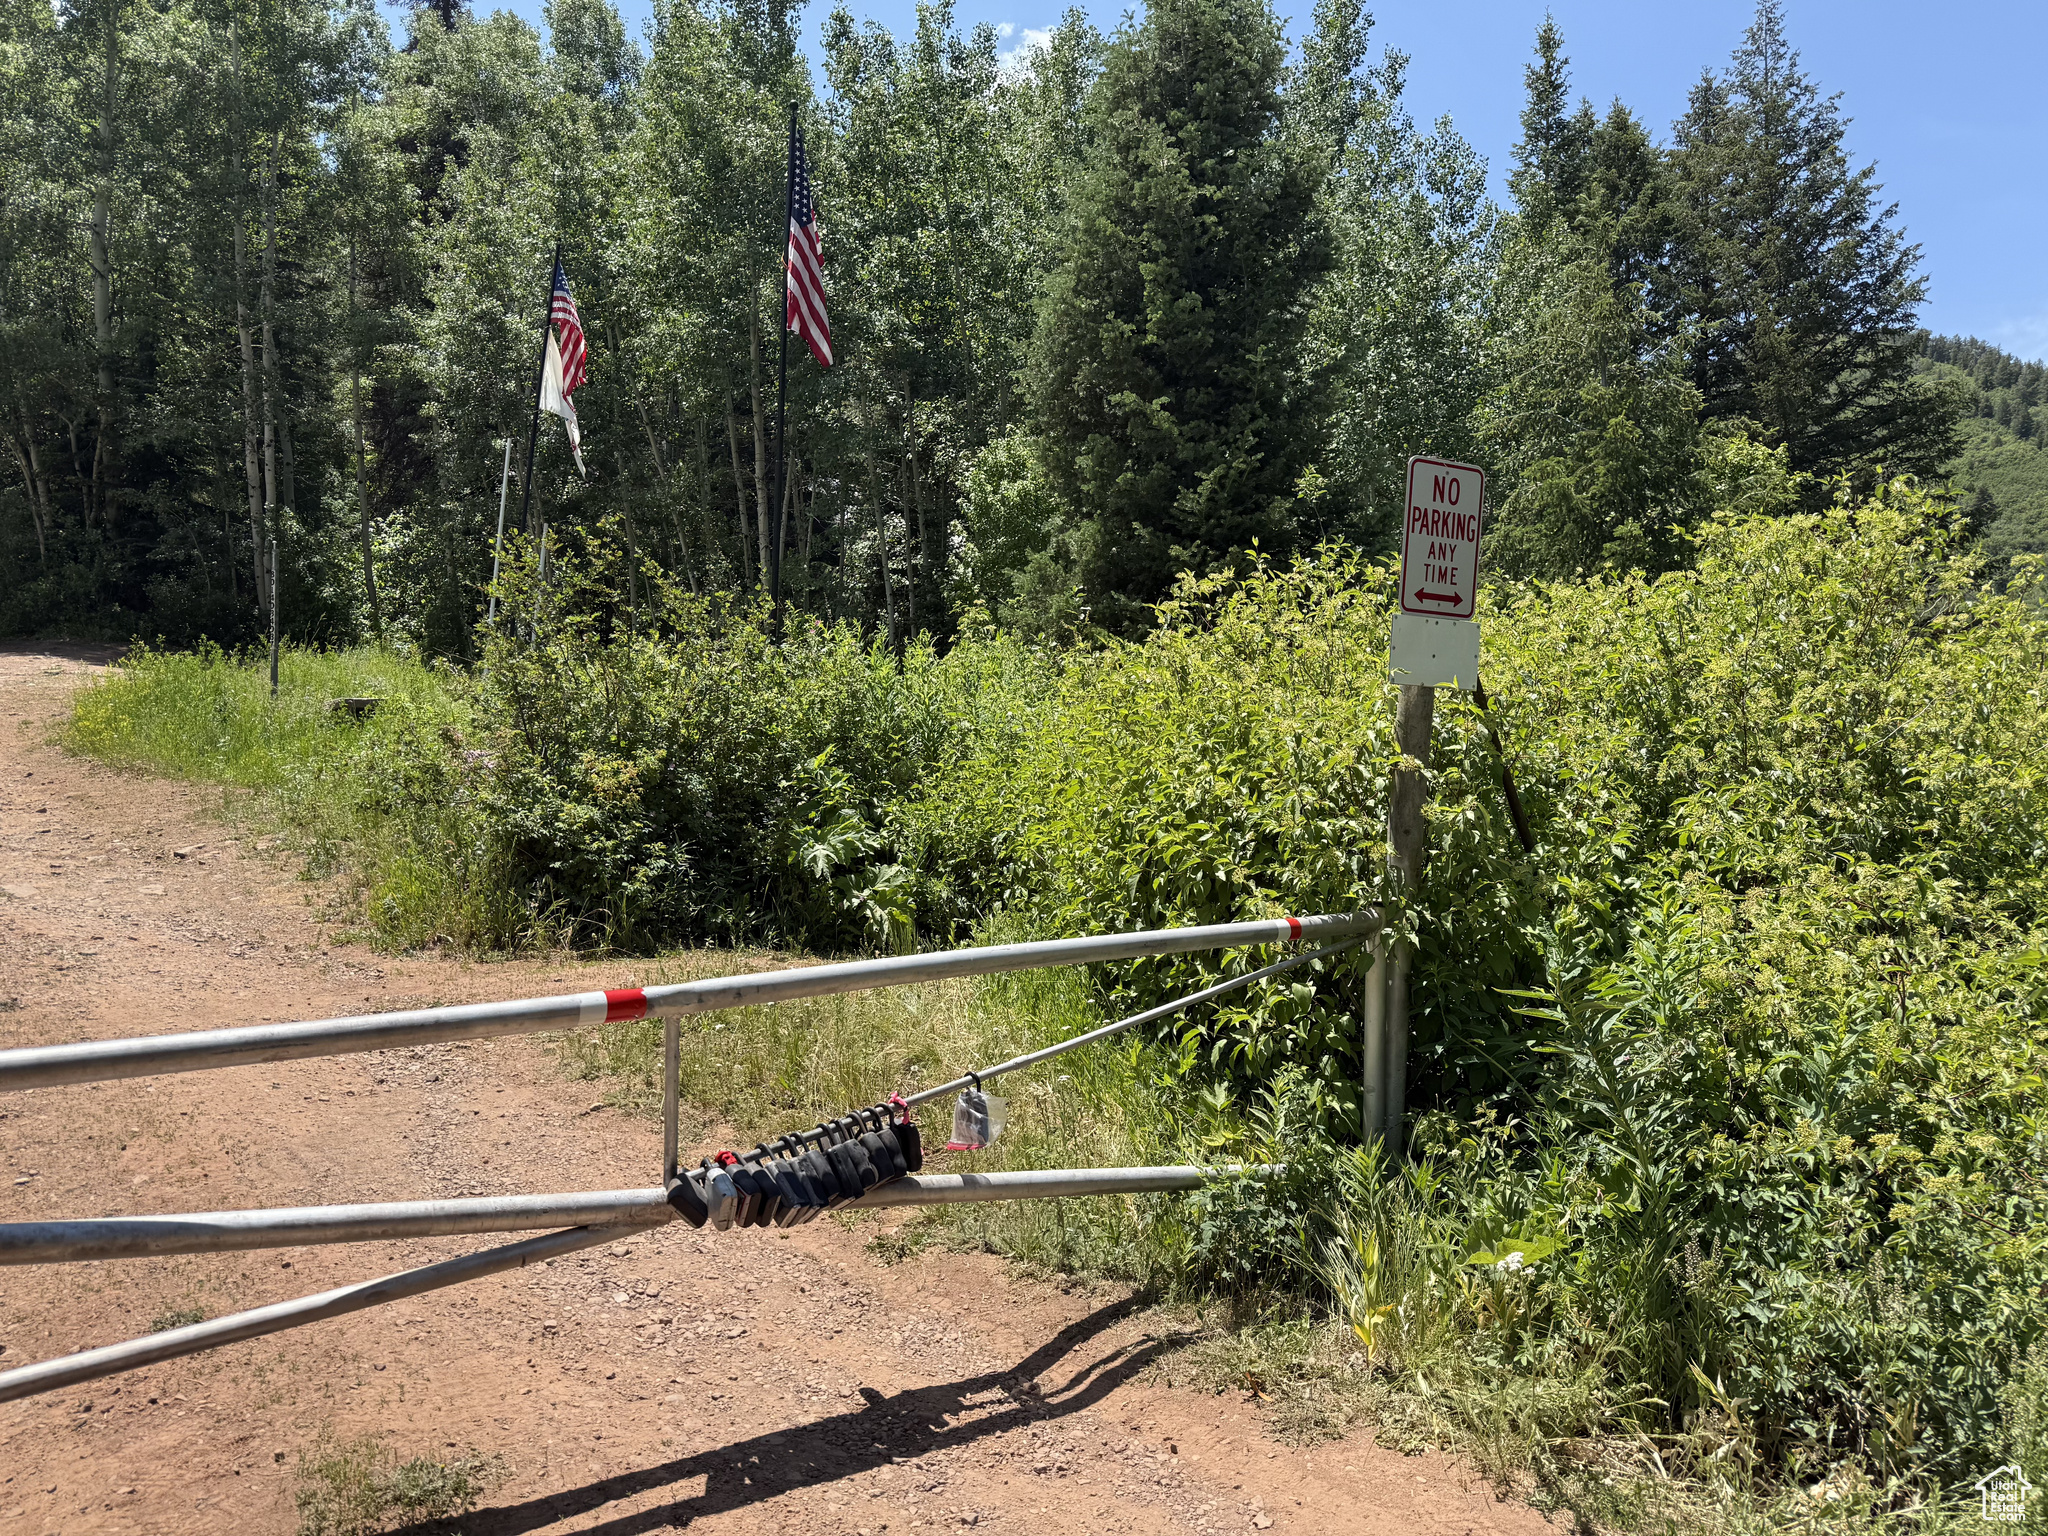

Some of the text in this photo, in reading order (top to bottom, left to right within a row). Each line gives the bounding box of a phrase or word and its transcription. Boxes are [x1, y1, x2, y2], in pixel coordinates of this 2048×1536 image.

[1433, 475, 1460, 506] NO
[1411, 506, 1476, 543] PARKING
[1427, 541, 1457, 563] ANY
[1424, 563, 1458, 586] TIME
